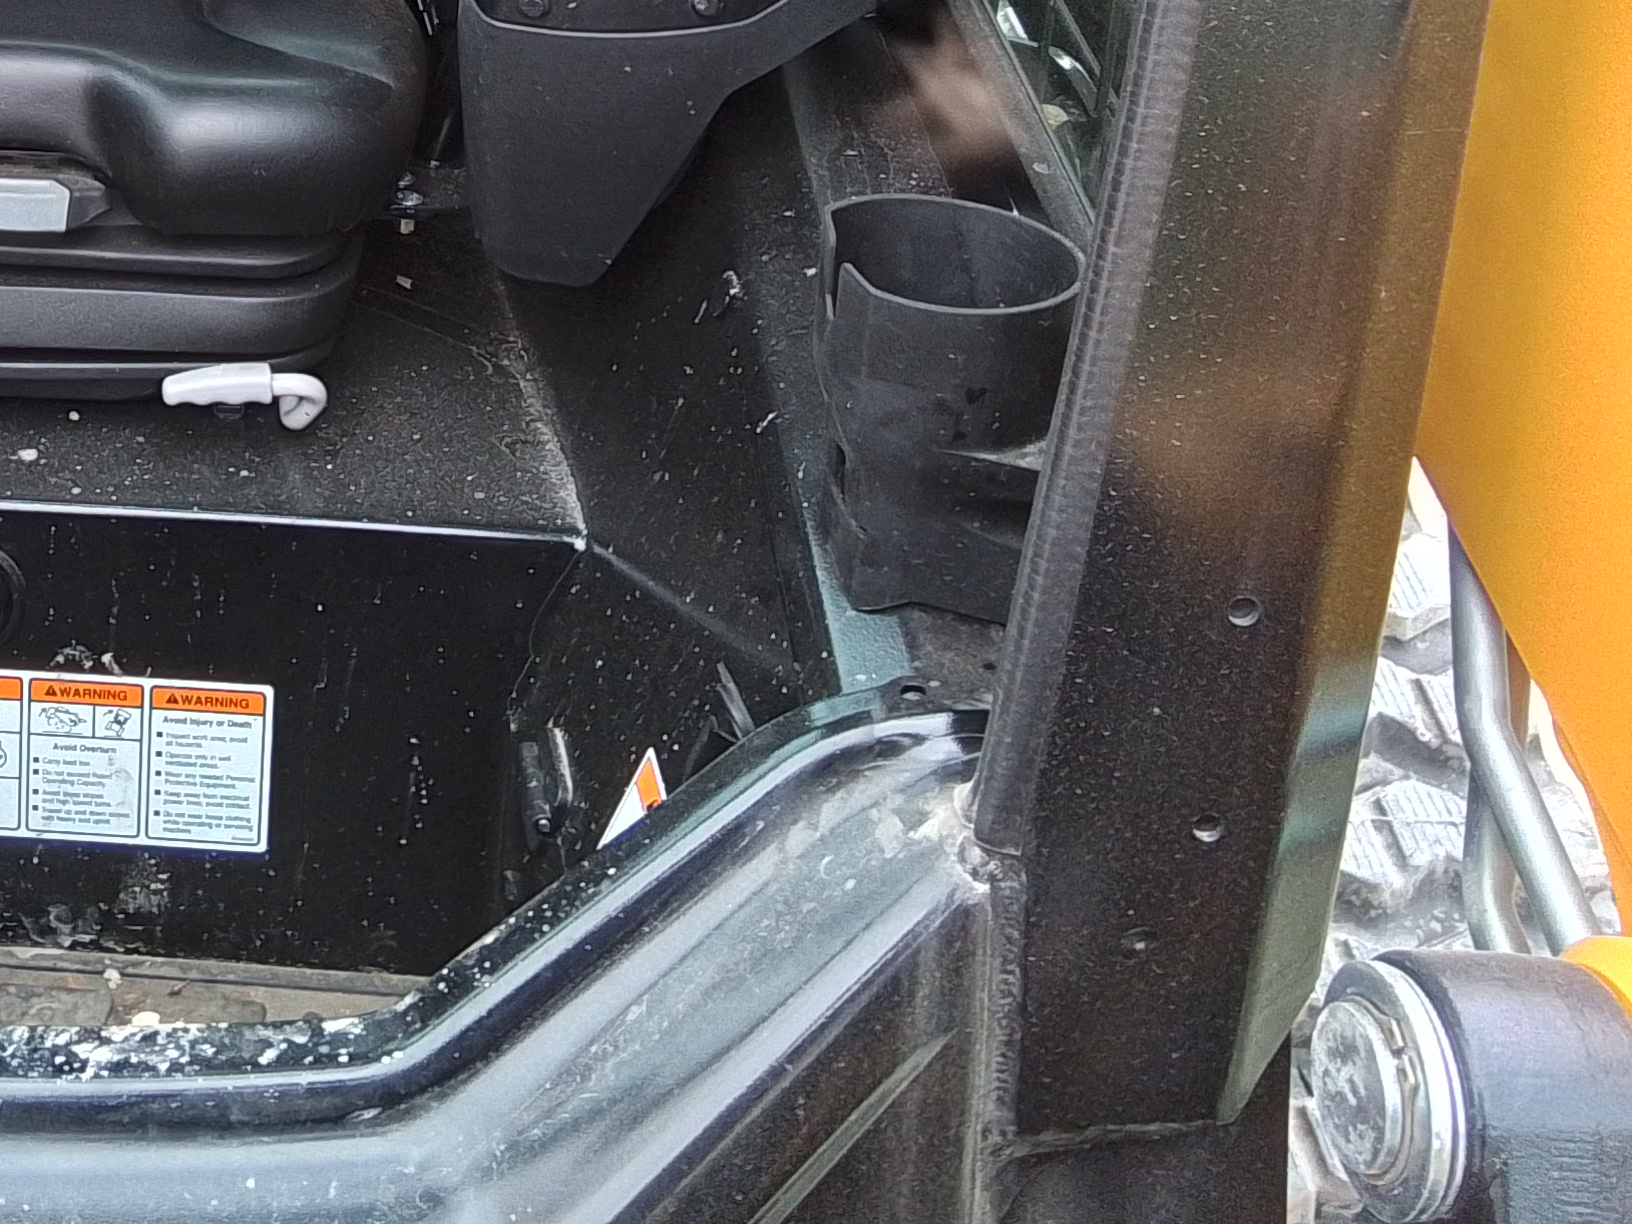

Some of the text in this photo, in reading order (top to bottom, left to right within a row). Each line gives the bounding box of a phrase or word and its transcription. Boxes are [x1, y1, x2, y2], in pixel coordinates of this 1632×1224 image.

[58, 686, 128, 702] WARNING
[180, 694, 250, 709] WARNING
[163, 716, 188, 725] Avoid
[189, 717, 214, 728] Injury
[53, 743, 117, 754] Avoid Overturn
